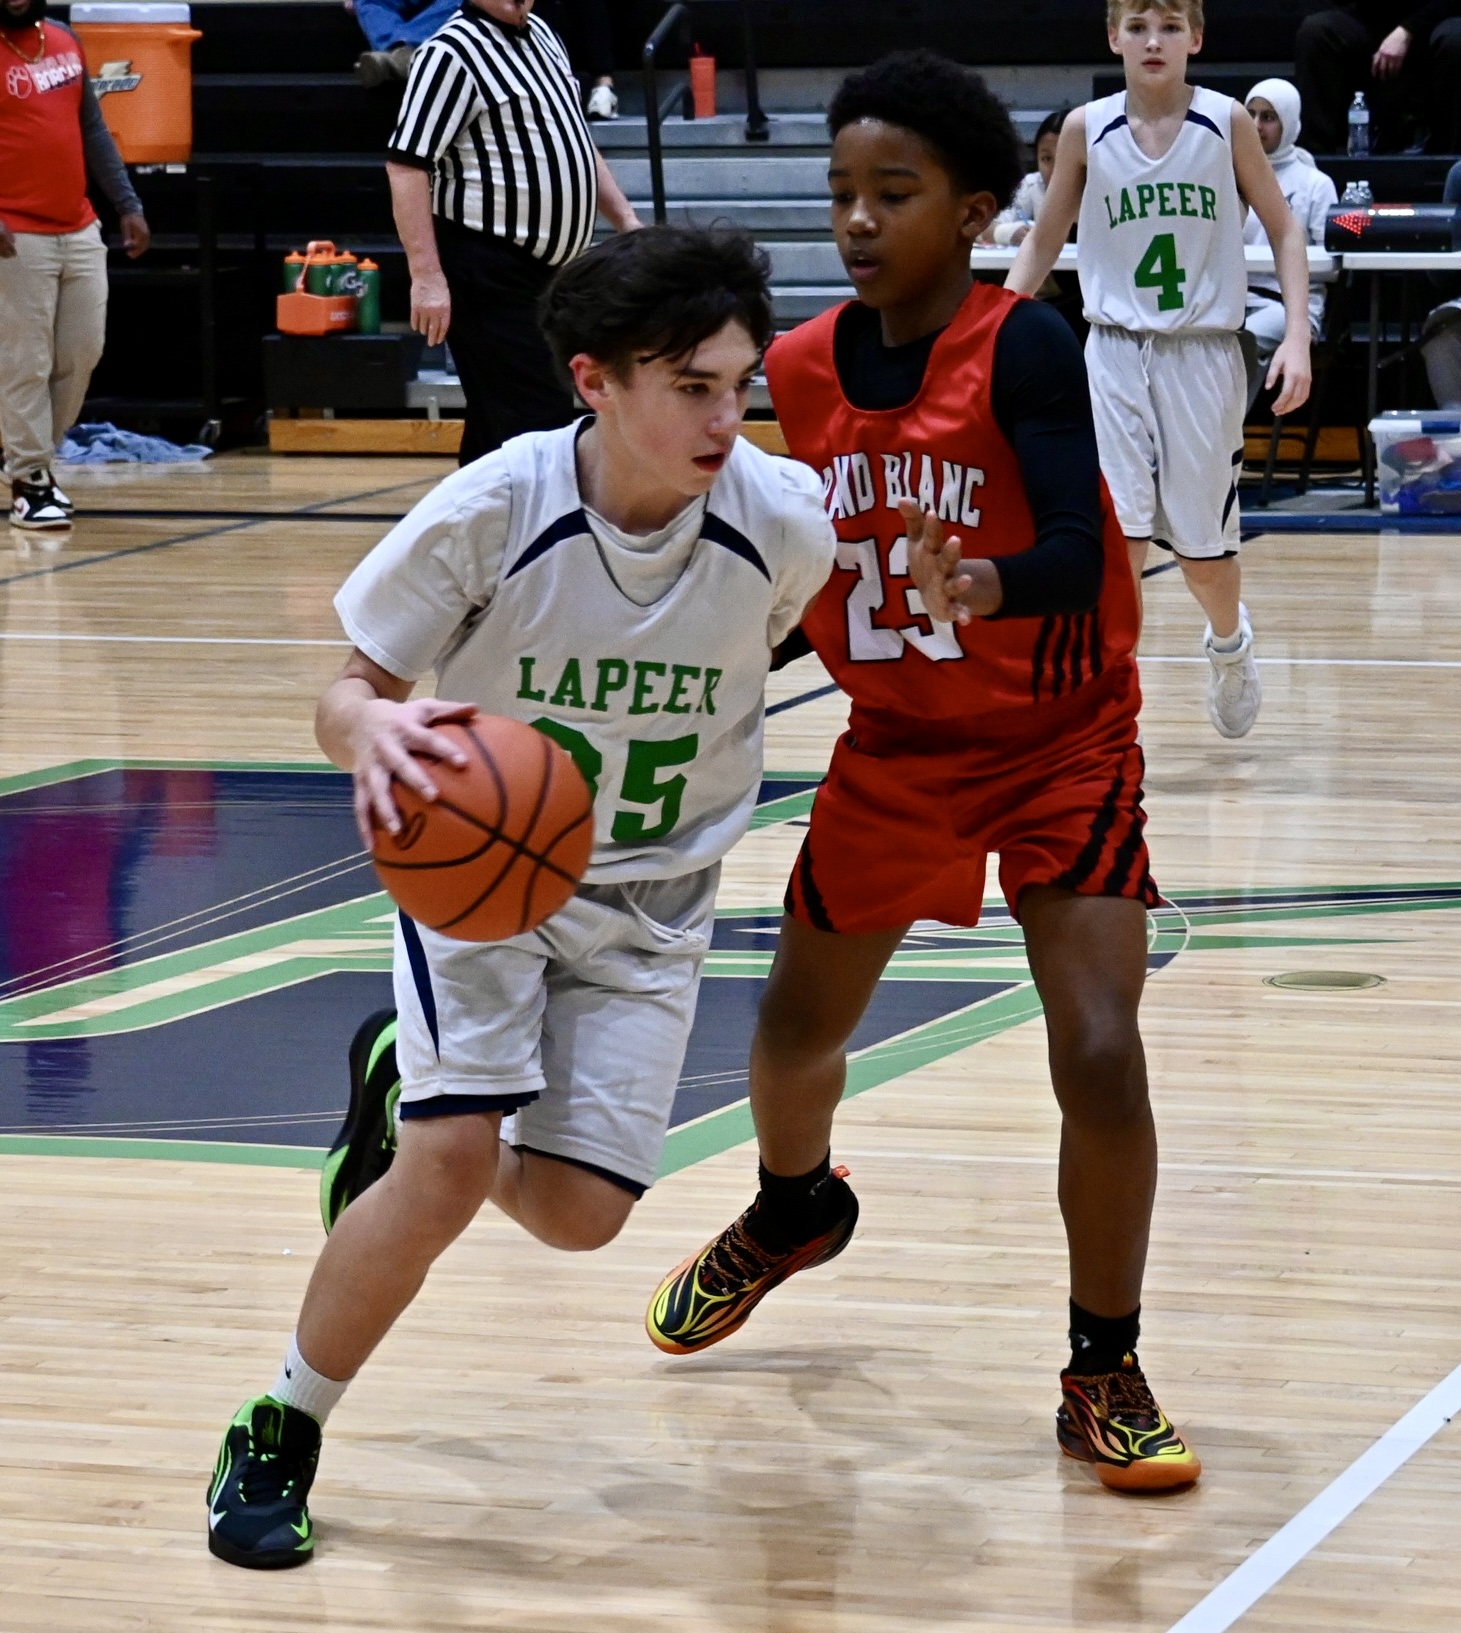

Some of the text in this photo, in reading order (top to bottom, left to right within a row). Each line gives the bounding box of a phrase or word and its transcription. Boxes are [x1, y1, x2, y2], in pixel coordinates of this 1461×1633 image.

[1104, 182, 1217, 230] LAPEER
[1134, 232, 1187, 312] 4
[880, 451, 986, 528] BLANC
[516, 656, 723, 716] LAPEER
